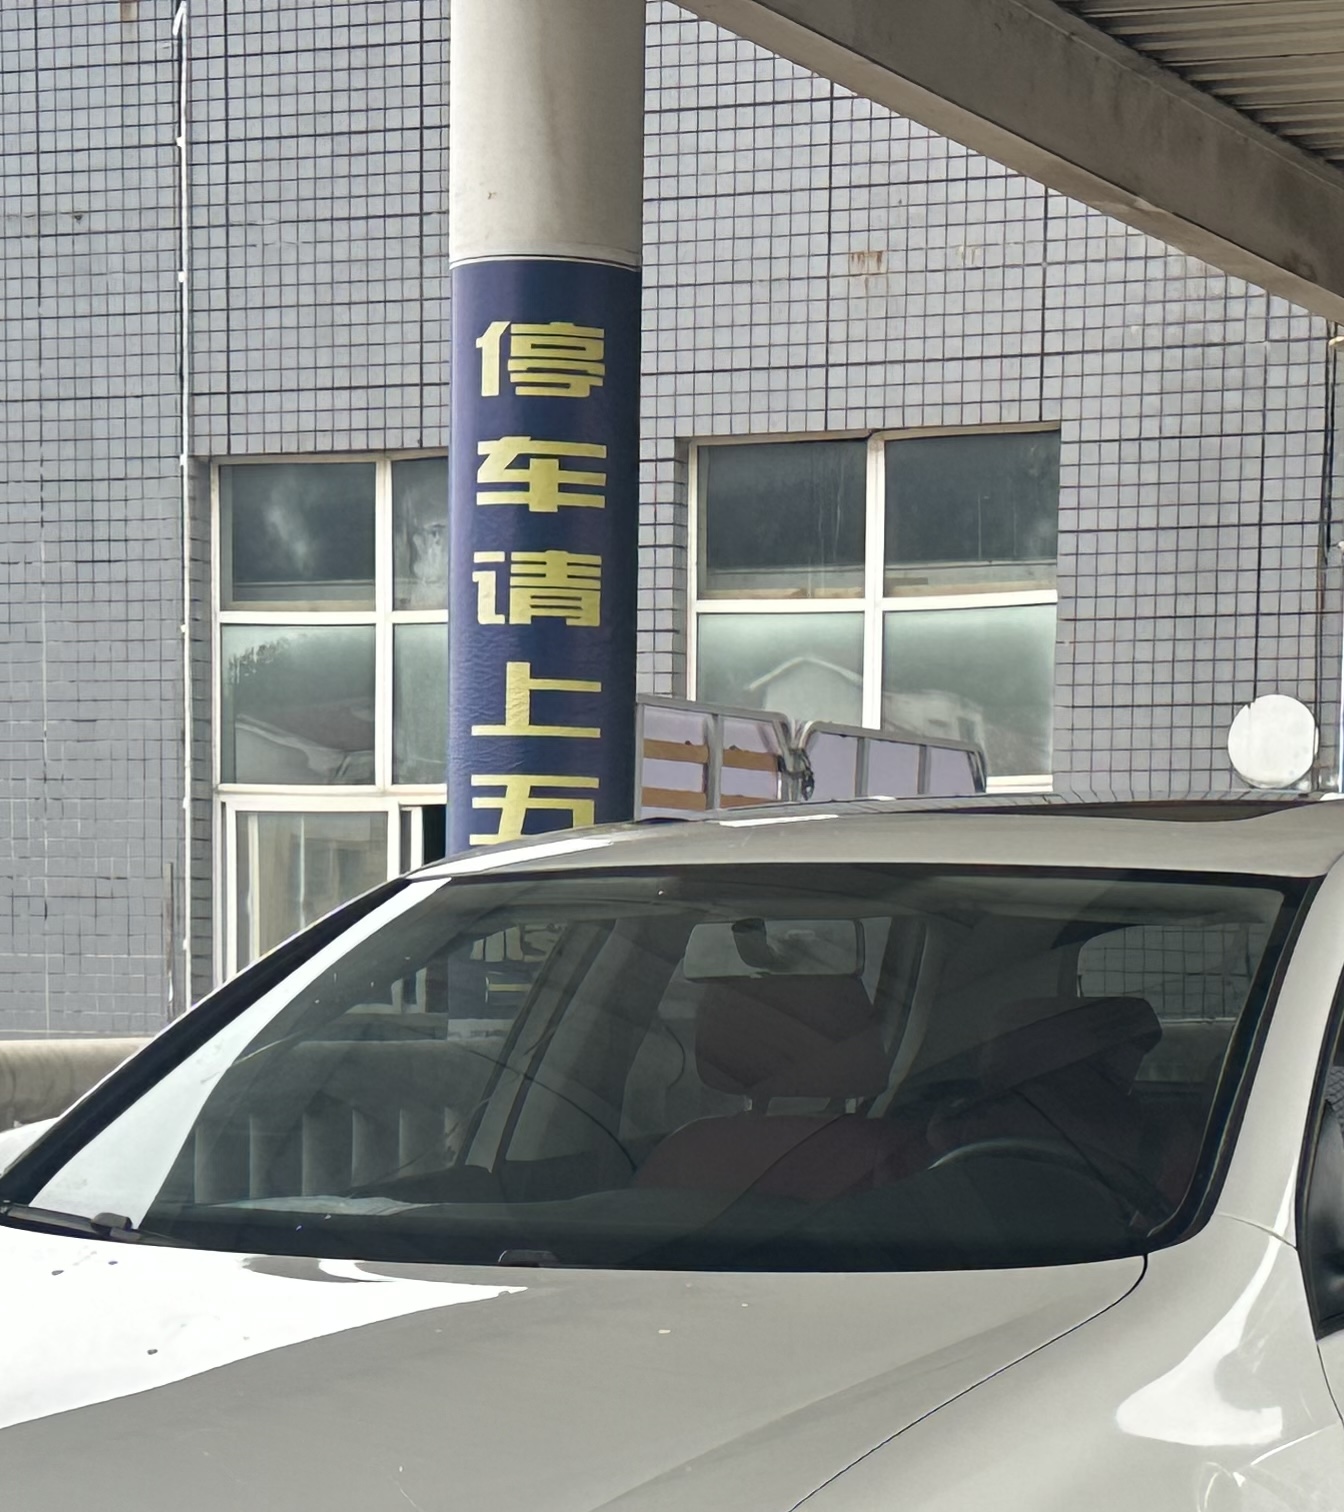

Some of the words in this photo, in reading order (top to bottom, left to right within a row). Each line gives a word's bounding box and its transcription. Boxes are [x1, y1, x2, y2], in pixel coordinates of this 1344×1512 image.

[470, 320, 608, 847] 停车请上五
